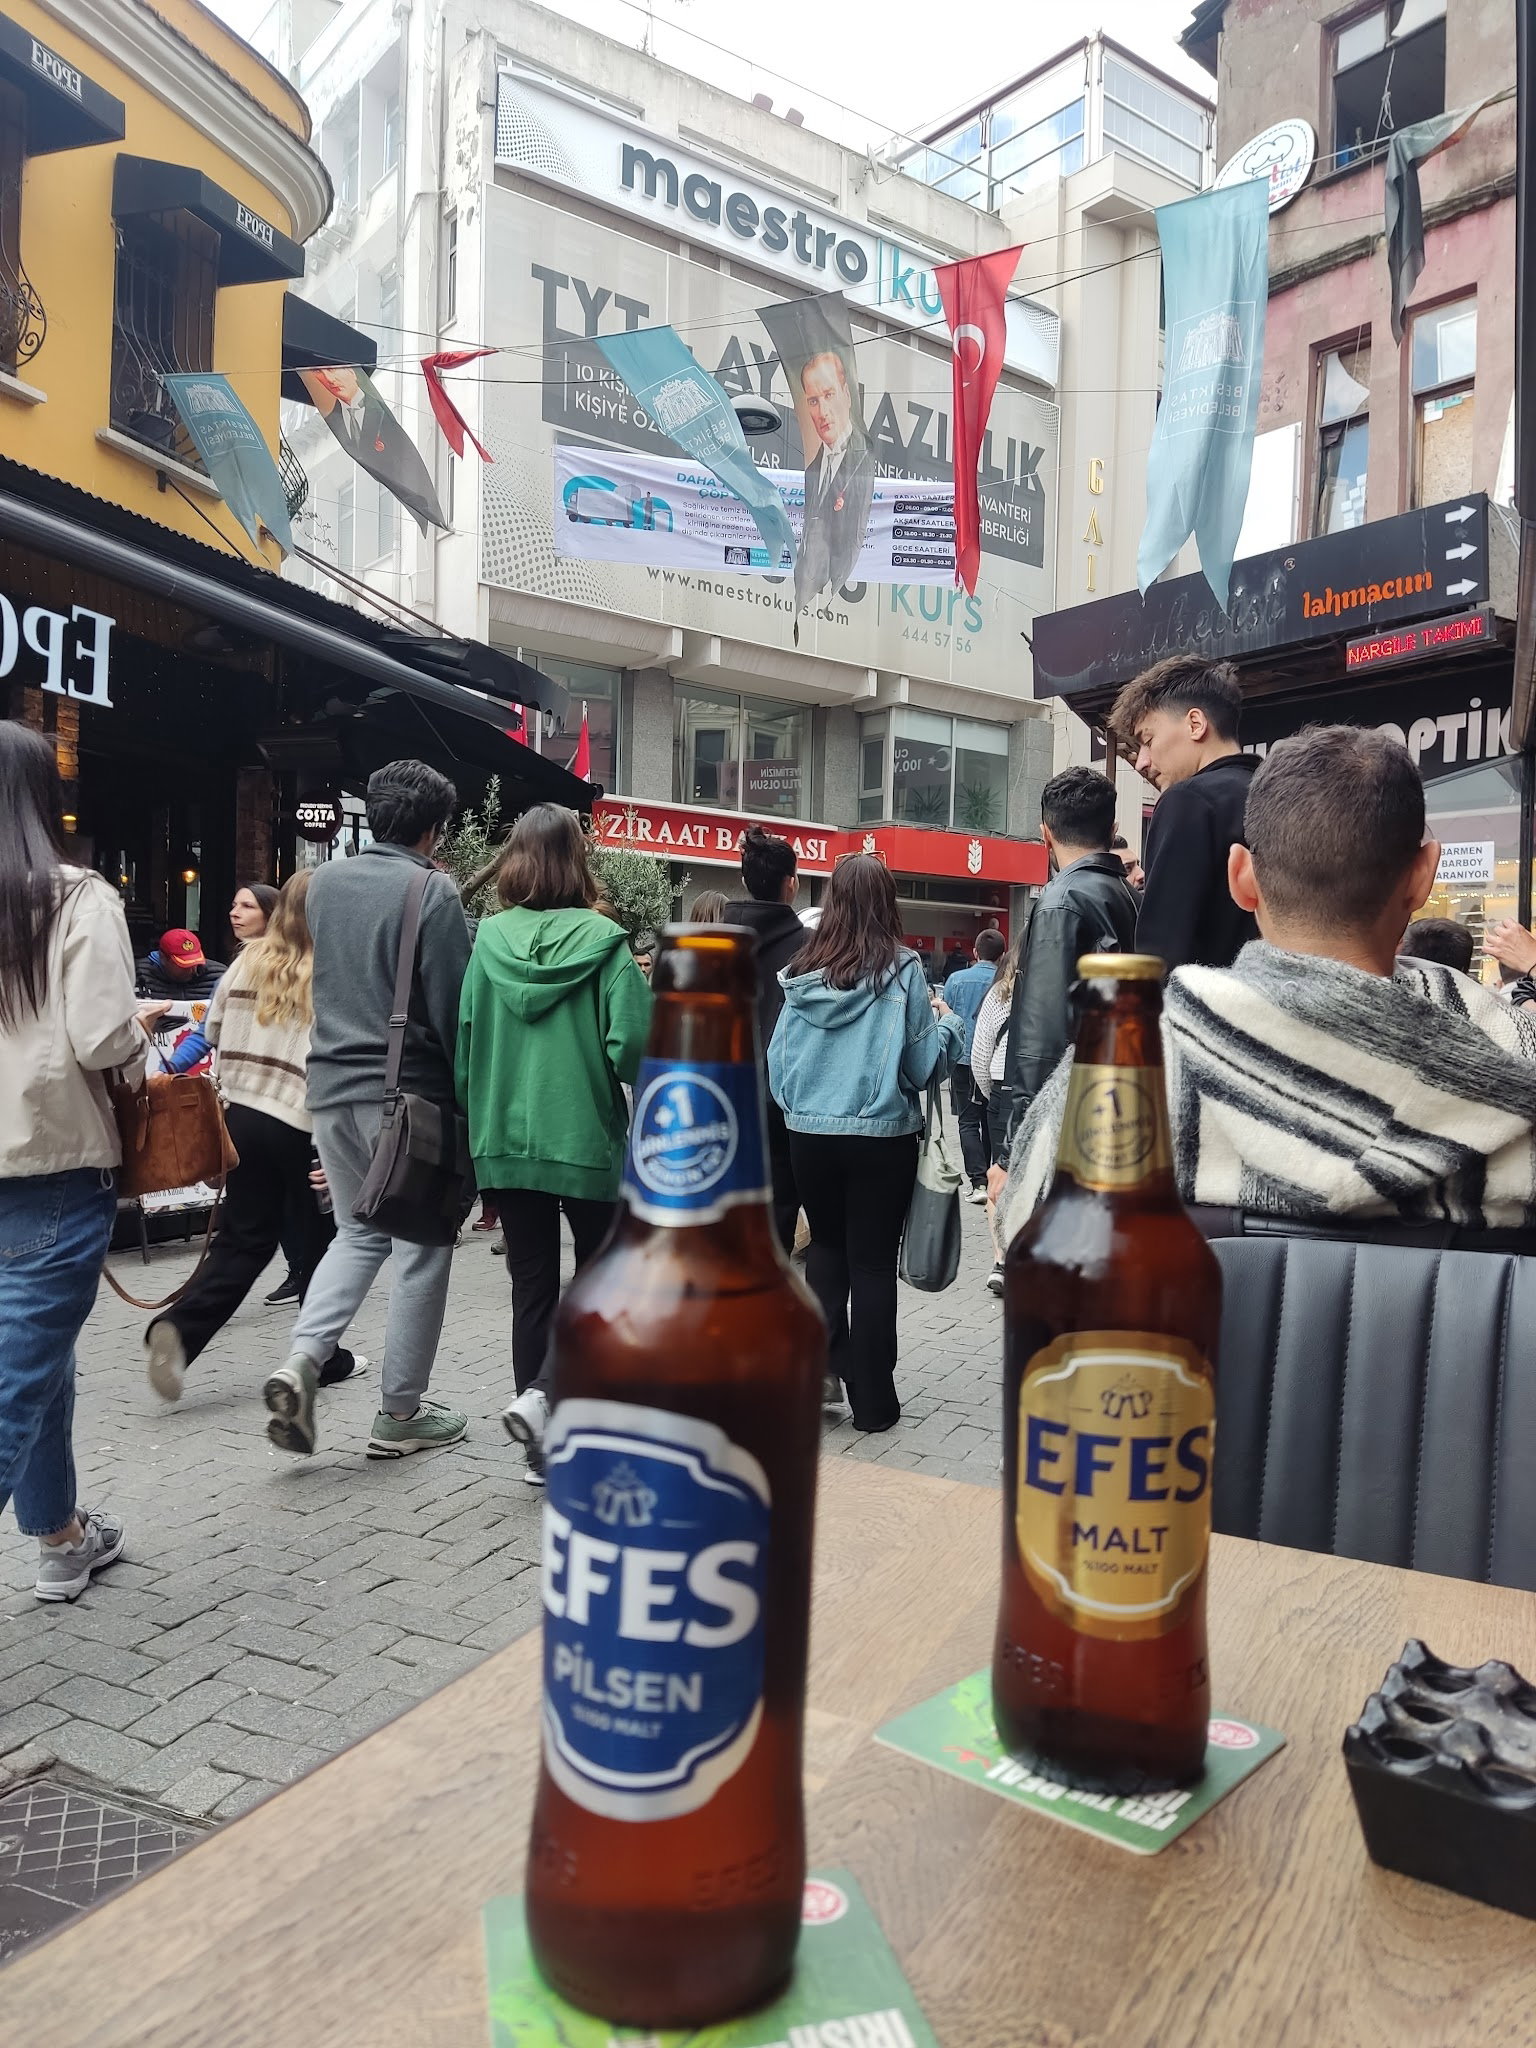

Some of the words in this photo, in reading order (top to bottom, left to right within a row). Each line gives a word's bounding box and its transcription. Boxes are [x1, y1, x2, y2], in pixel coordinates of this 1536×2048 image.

[621, 142, 868, 283] maestro
[889, 246, 942, 316] ku
[531, 263, 649, 338] TYT
[575, 363, 594, 382] 10
[575, 389, 628, 425] KİŞİYE
[677, 473, 717, 487] DAHA
[699, 488, 729, 499] ÇÖP
[1302, 570, 1433, 618] lahmacun
[902, 625, 929, 643] 444
[934, 631, 951, 649] 57
[955, 637, 972, 654] 56
[1348, 633, 1416, 664] NARGİLE
[296, 809, 335, 822] COSTA
[605, 812, 709, 849] ZİRAAT
[1436, 870, 1489, 880] ARANIYOR
[1441, 858, 1483, 868] BARBOY
[1025, 1414, 1209, 1504] EFES
[1071, 1521, 1169, 1552] MALT
[543, 1500, 760, 1649] EFES
[1123, 1563, 1159, 1575] MALT
[553, 1641, 703, 1712] PİLSEN
[612, 1716, 663, 1739] MALT
